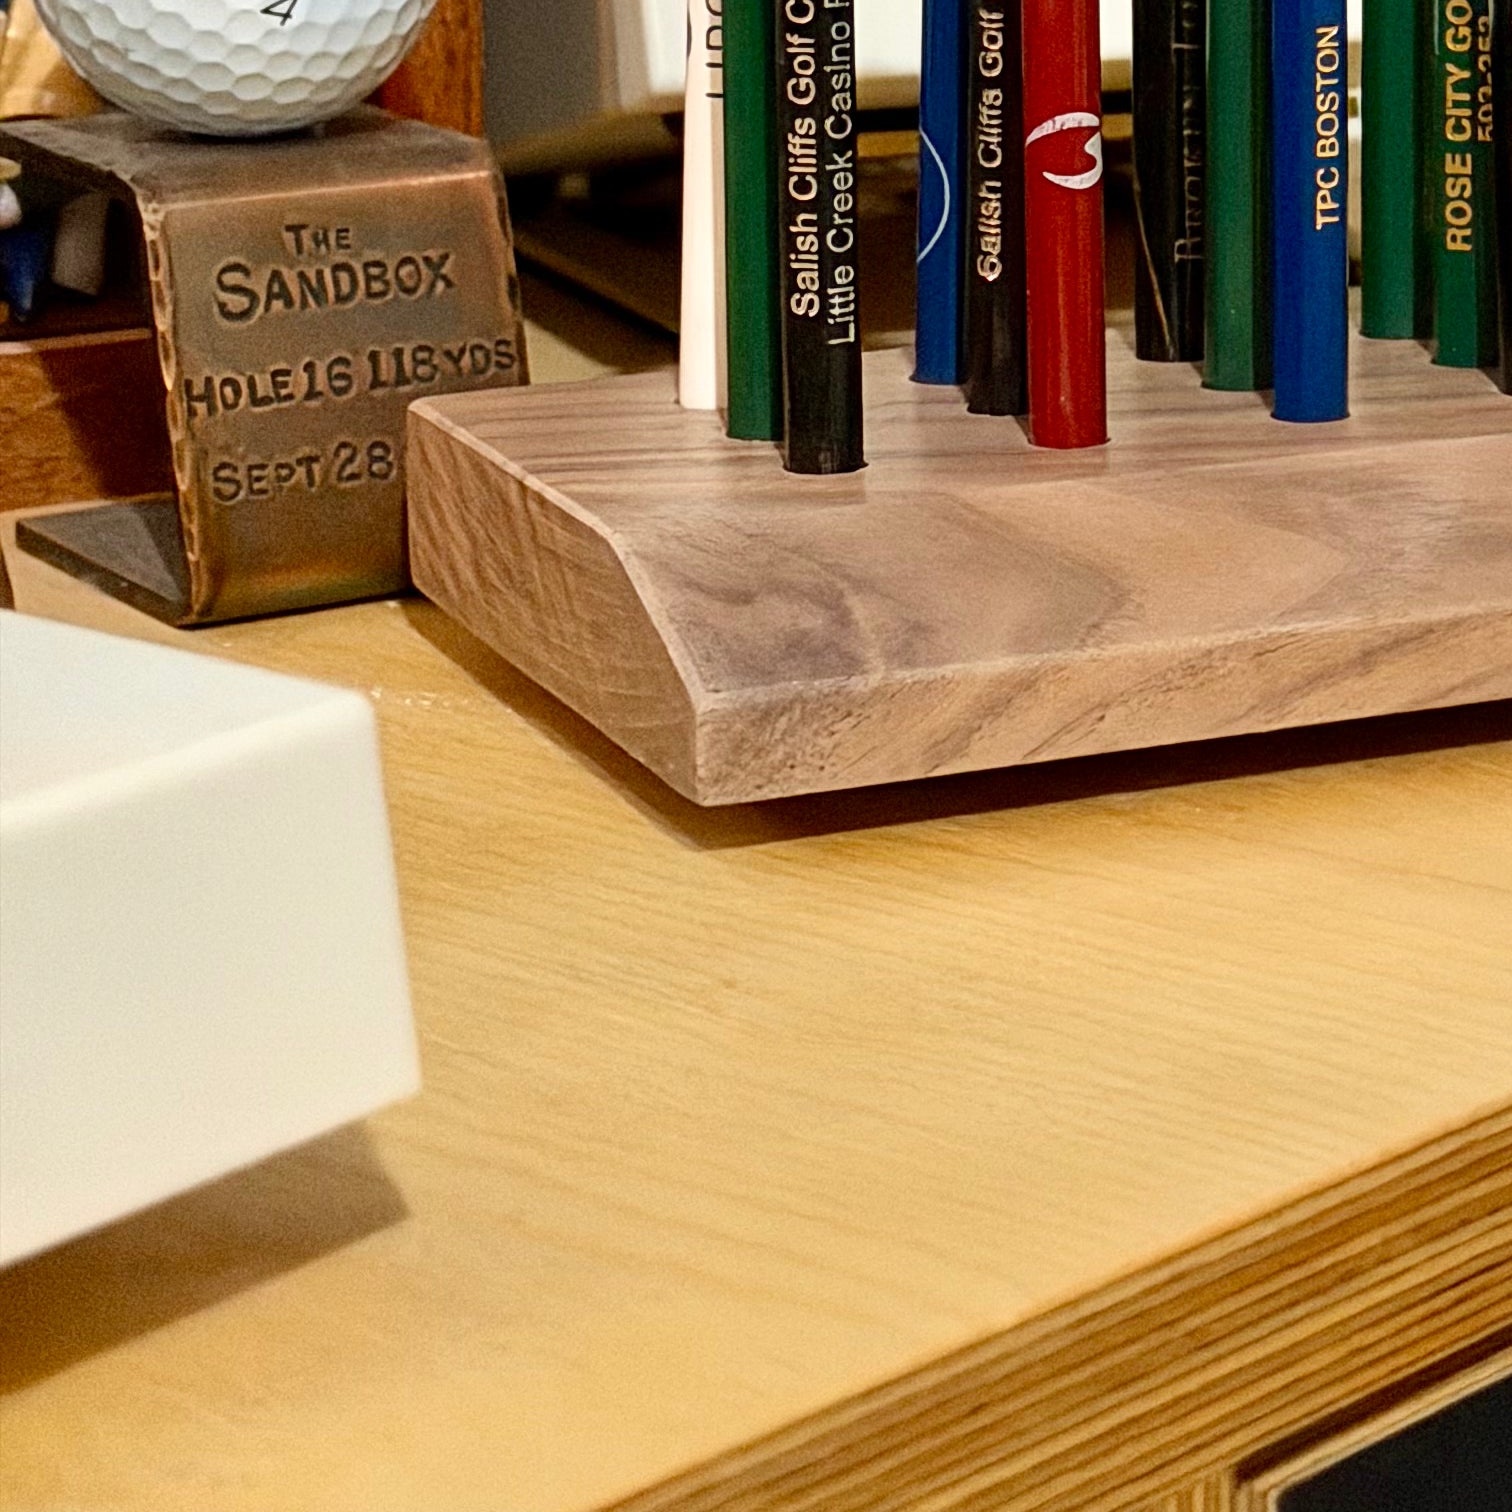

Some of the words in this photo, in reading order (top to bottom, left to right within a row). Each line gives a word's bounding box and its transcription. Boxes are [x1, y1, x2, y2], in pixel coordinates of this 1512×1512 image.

[784, 33, 817, 106] Golf
[823, 21, 852, 140] Casino
[978, 8, 1005, 78] Golf
[976, 88, 1003, 169] Cliffs
[1315, 25, 1340, 159] BOSTON
[1445, 62, 1473, 143] CITY
[786, 116, 819, 201] Cliffs
[1315, 166, 1340, 231] TPC
[284, 223, 351, 257] THE
[825, 150, 854, 254] Creek
[976, 180, 1003, 282] Salish
[1445, 152, 1473, 253] ROSE
[215, 251, 456, 323] SANDBOX
[789, 212, 821, 317] Salish
[826, 265, 856, 345] Little
[183, 368, 295, 418] HOLE
[302, 355, 353, 402] 16
[212, 454, 321, 503] SEPT
[332, 440, 394, 484] 28
